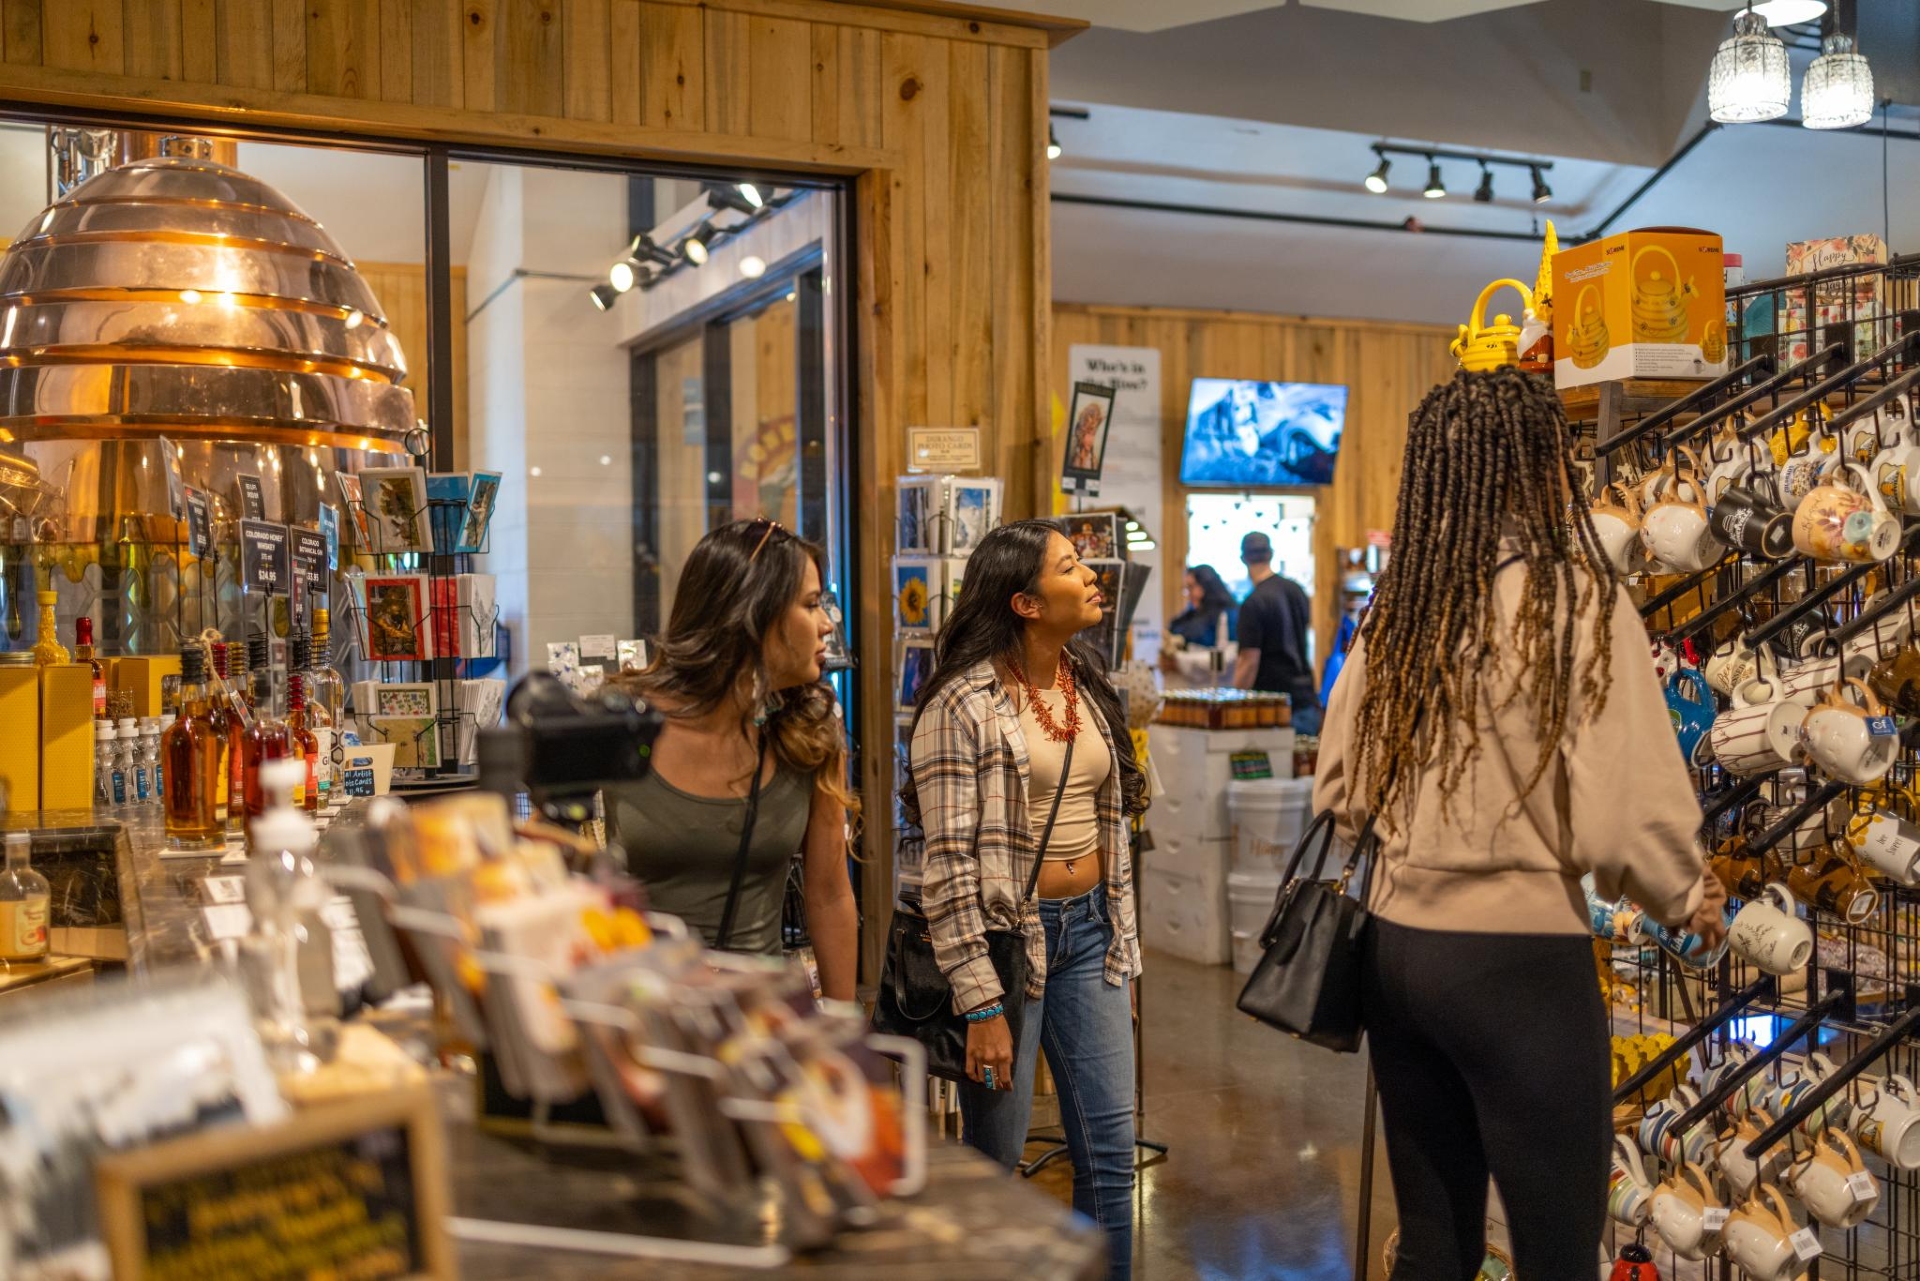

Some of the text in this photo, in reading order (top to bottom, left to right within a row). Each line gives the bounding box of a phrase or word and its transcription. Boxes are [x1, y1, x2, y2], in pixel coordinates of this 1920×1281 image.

[1812, 249, 1855, 271] Happy
[1085, 358, 1146, 374] Who's in
[926, 435, 964, 443] DURANGO
[245, 530, 284, 542] COLORADO HONEY
[256, 541, 275, 551] WHISKEY
[301, 537, 320, 547] COLORADO
[258, 570, 277, 581] $24.95
[353, 770, 373, 778] Artist
